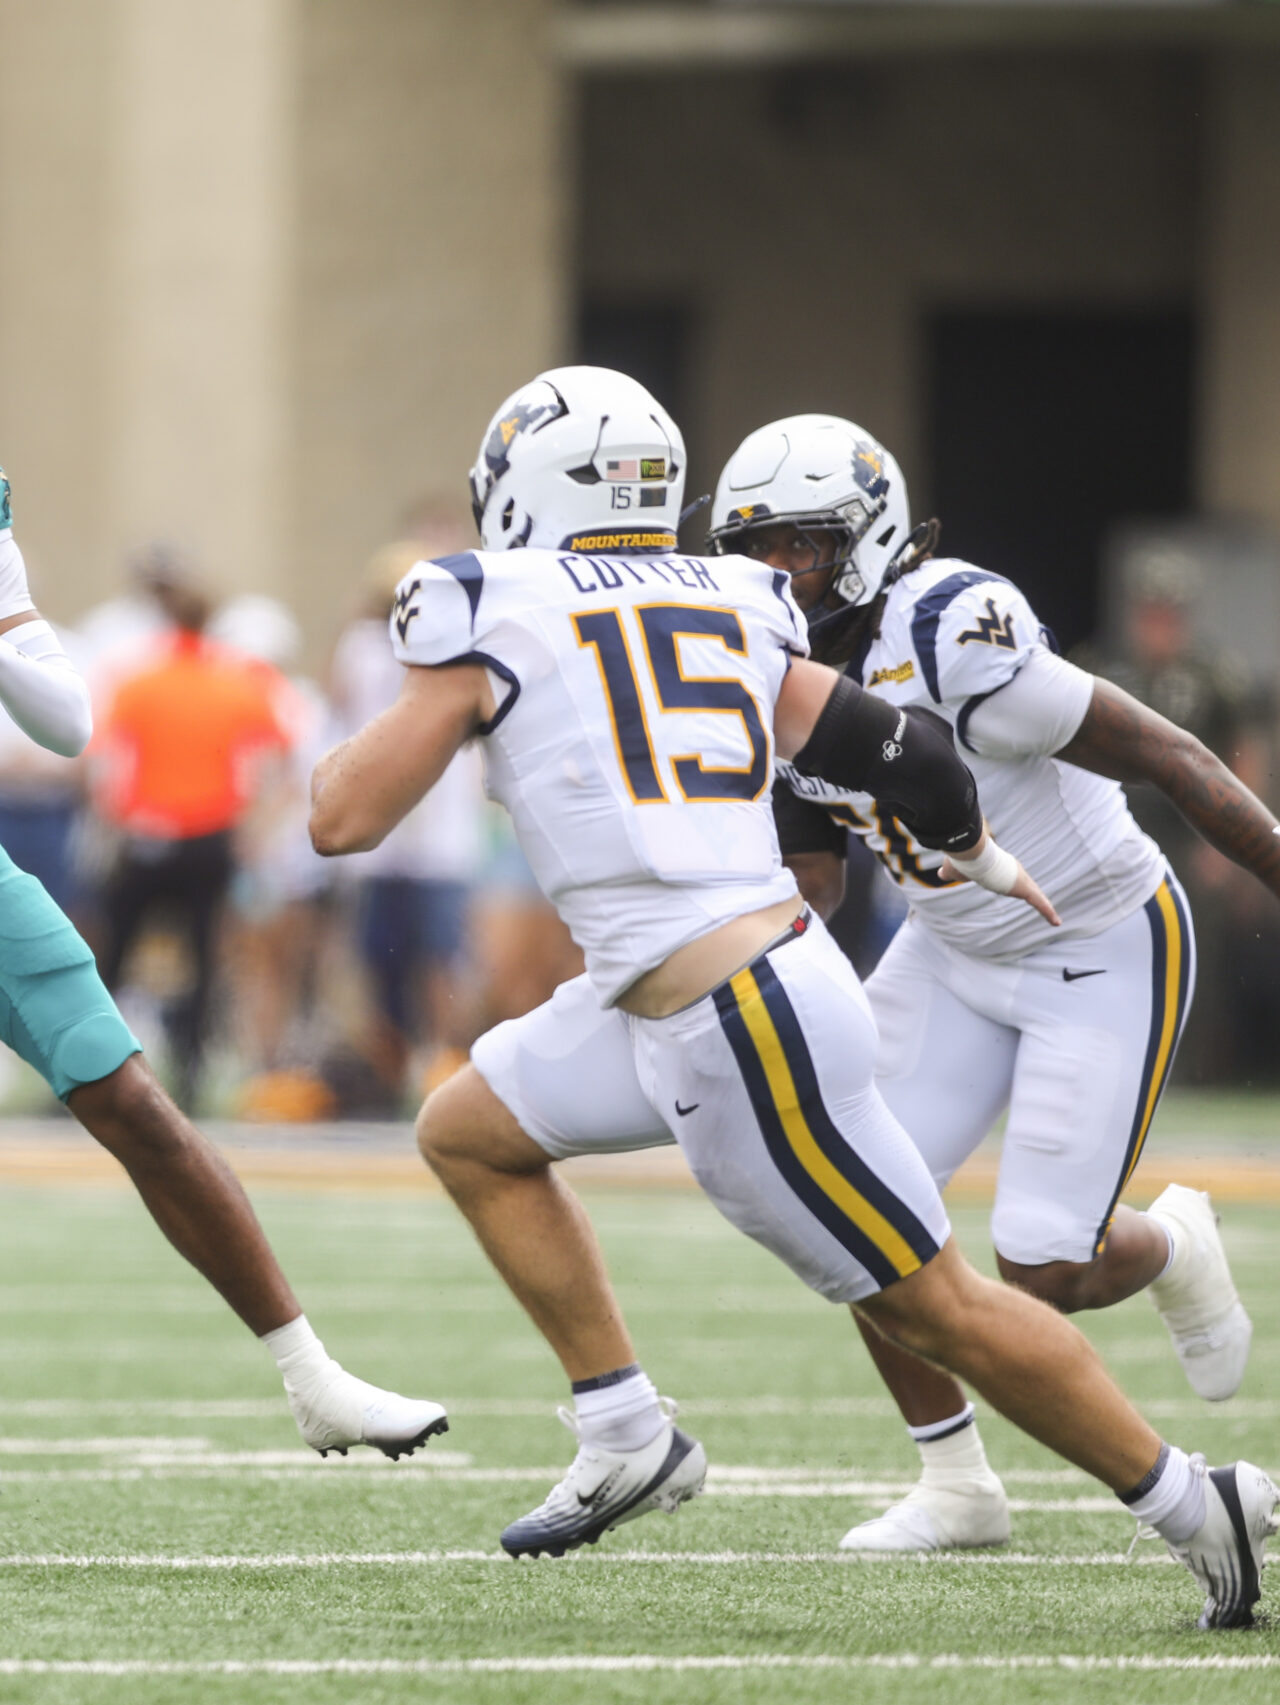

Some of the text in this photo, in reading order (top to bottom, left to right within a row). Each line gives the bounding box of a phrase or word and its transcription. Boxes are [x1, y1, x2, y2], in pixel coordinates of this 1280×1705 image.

[611, 486, 631, 509] 15
[571, 534, 677, 550] MOUNTAINEERS
[558, 556, 720, 592] CUTTER
[570, 604, 770, 804] 15
